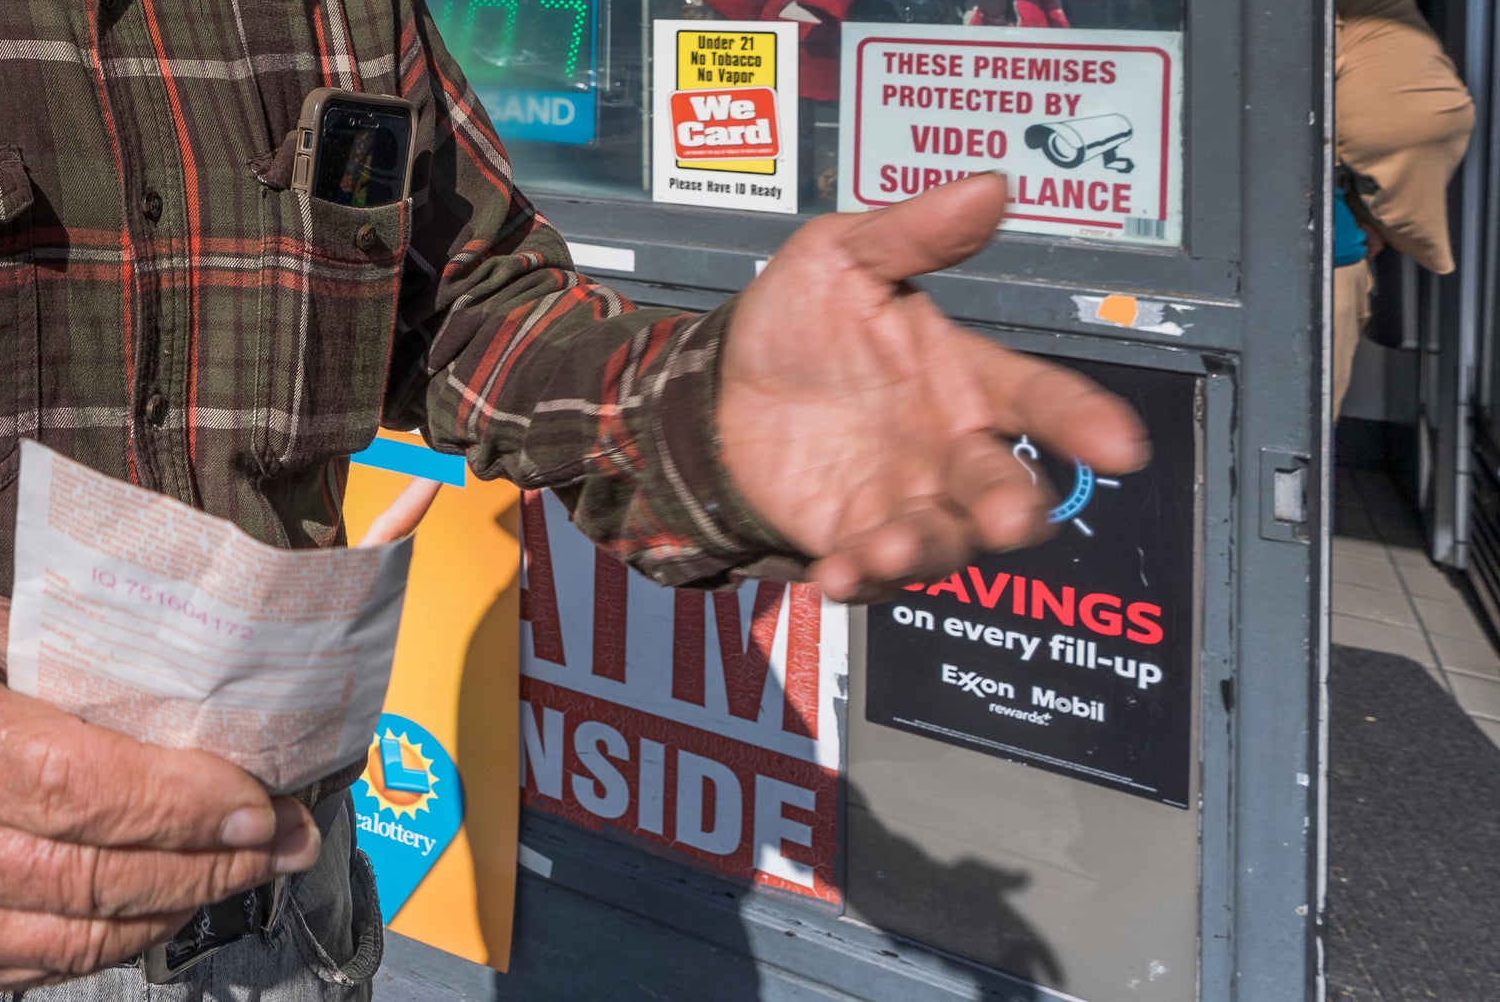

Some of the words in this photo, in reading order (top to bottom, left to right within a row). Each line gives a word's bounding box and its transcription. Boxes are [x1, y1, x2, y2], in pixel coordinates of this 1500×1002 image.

[698, 36, 735, 50] Under
[740, 37, 754, 50] 21
[691, 52, 705, 65] No
[712, 52, 761, 67] Tobacco
[883, 52, 963, 77] THESE
[973, 56, 1117, 84] PREMISES
[698, 68, 712, 82] No
[718, 69, 754, 85] Vapor
[689, 95, 756, 121] We
[882, 84, 1033, 114] PROTECTED
[1045, 93, 1082, 117] BY
[677, 118, 772, 147] Card
[910, 125, 1007, 159] VIDEO
[669, 178, 702, 192] Please
[707, 181, 731, 194] Have
[736, 183, 745, 195] ID
[751, 184, 782, 199] Ready
[880, 165, 1132, 213] SURLANCE
[902, 566, 1164, 645] AVINGS
[892, 605, 935, 631] on
[943, 617, 1041, 661] every
[1049, 633, 1164, 690] fill-up
[941, 663, 1015, 699] Exxon
[1031, 685, 1106, 723] Mobil
[520, 699, 817, 890] NSIDE
